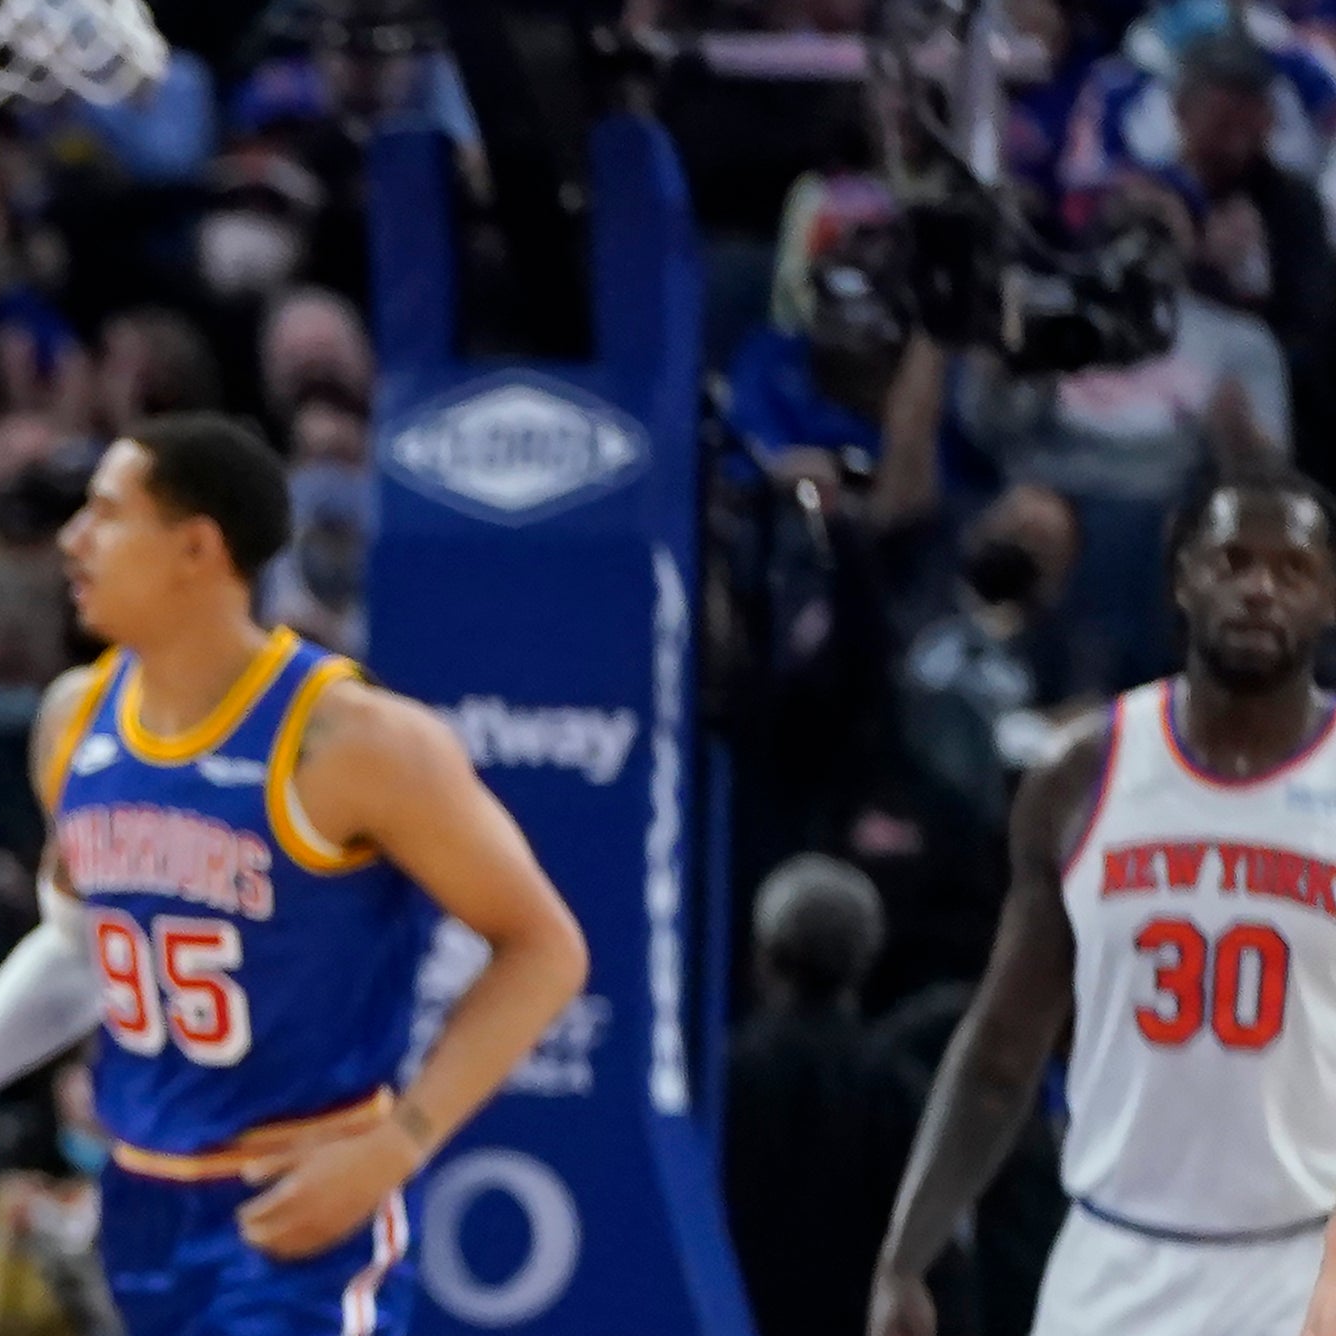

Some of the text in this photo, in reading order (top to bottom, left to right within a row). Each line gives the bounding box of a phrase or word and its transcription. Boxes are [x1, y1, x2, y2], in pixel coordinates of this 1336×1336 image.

[436, 694, 639, 786] tway
[59, 803, 275, 921] WARRIORS
[1102, 841, 1214, 899] NEW
[85, 905, 253, 1068] 95
[1134, 917, 1291, 1051] 30
